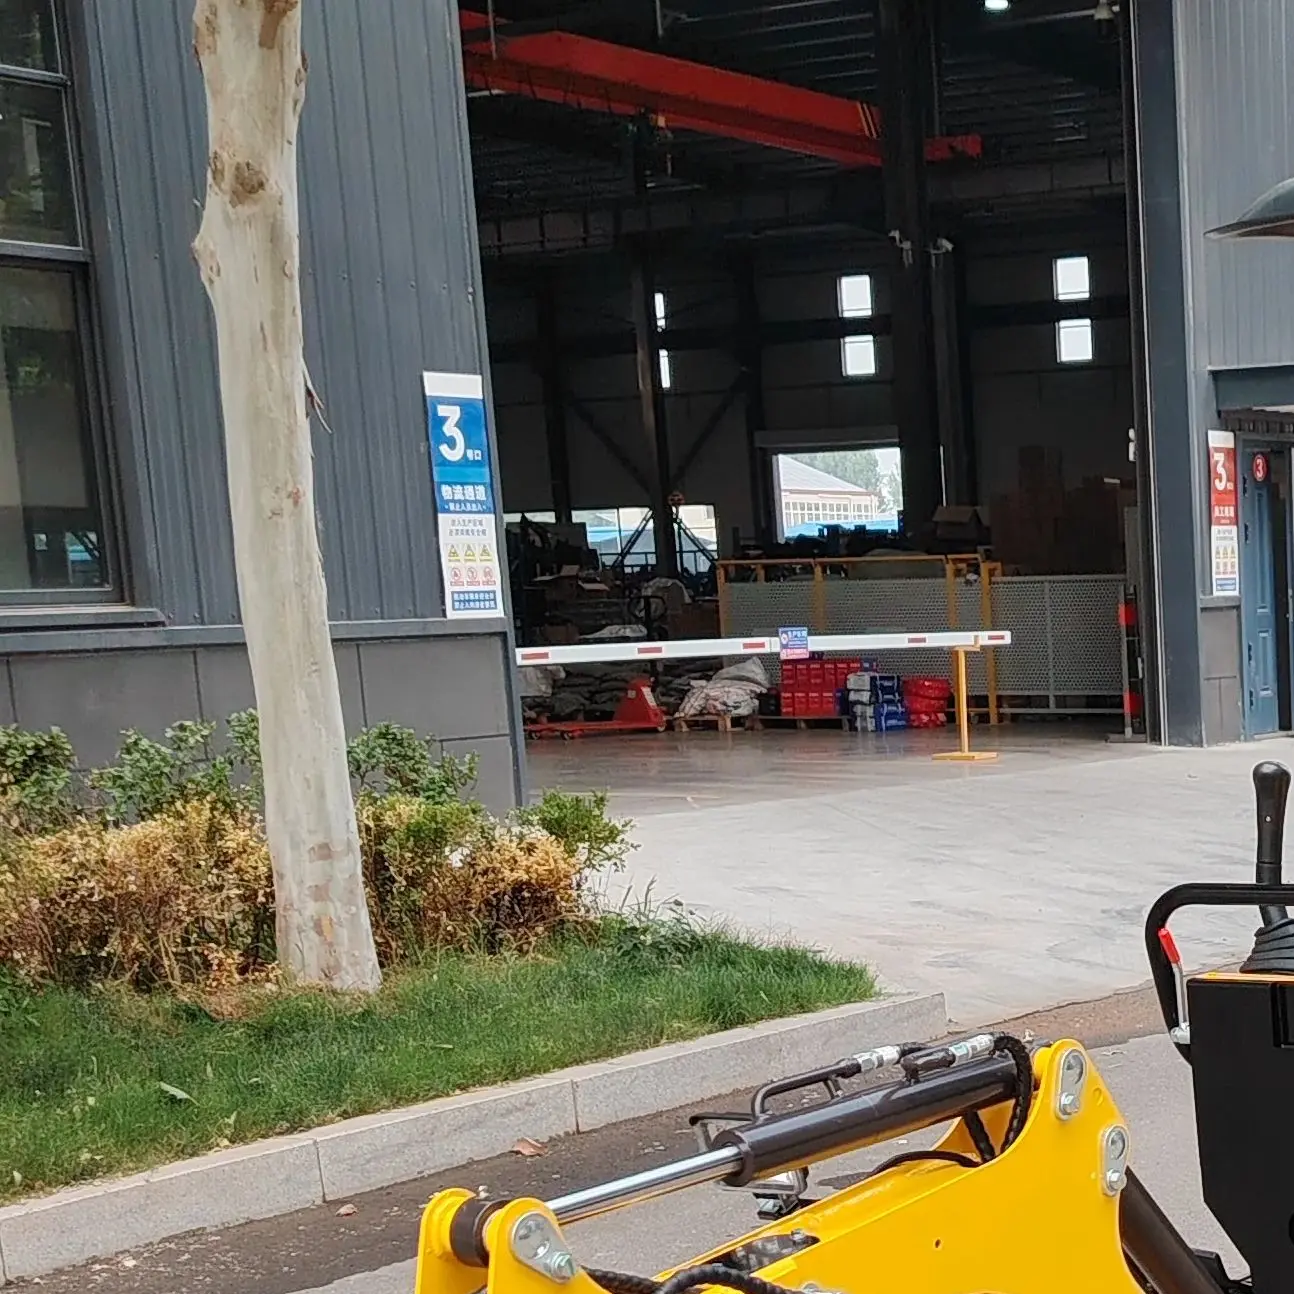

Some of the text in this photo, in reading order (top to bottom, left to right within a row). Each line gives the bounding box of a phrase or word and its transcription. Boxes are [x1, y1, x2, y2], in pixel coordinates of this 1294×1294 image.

[436, 404, 466, 462] 3
[1213, 452, 1227, 491] 3
[1256, 458, 1263, 477] 3
[440, 484, 487, 501] 物流通道
